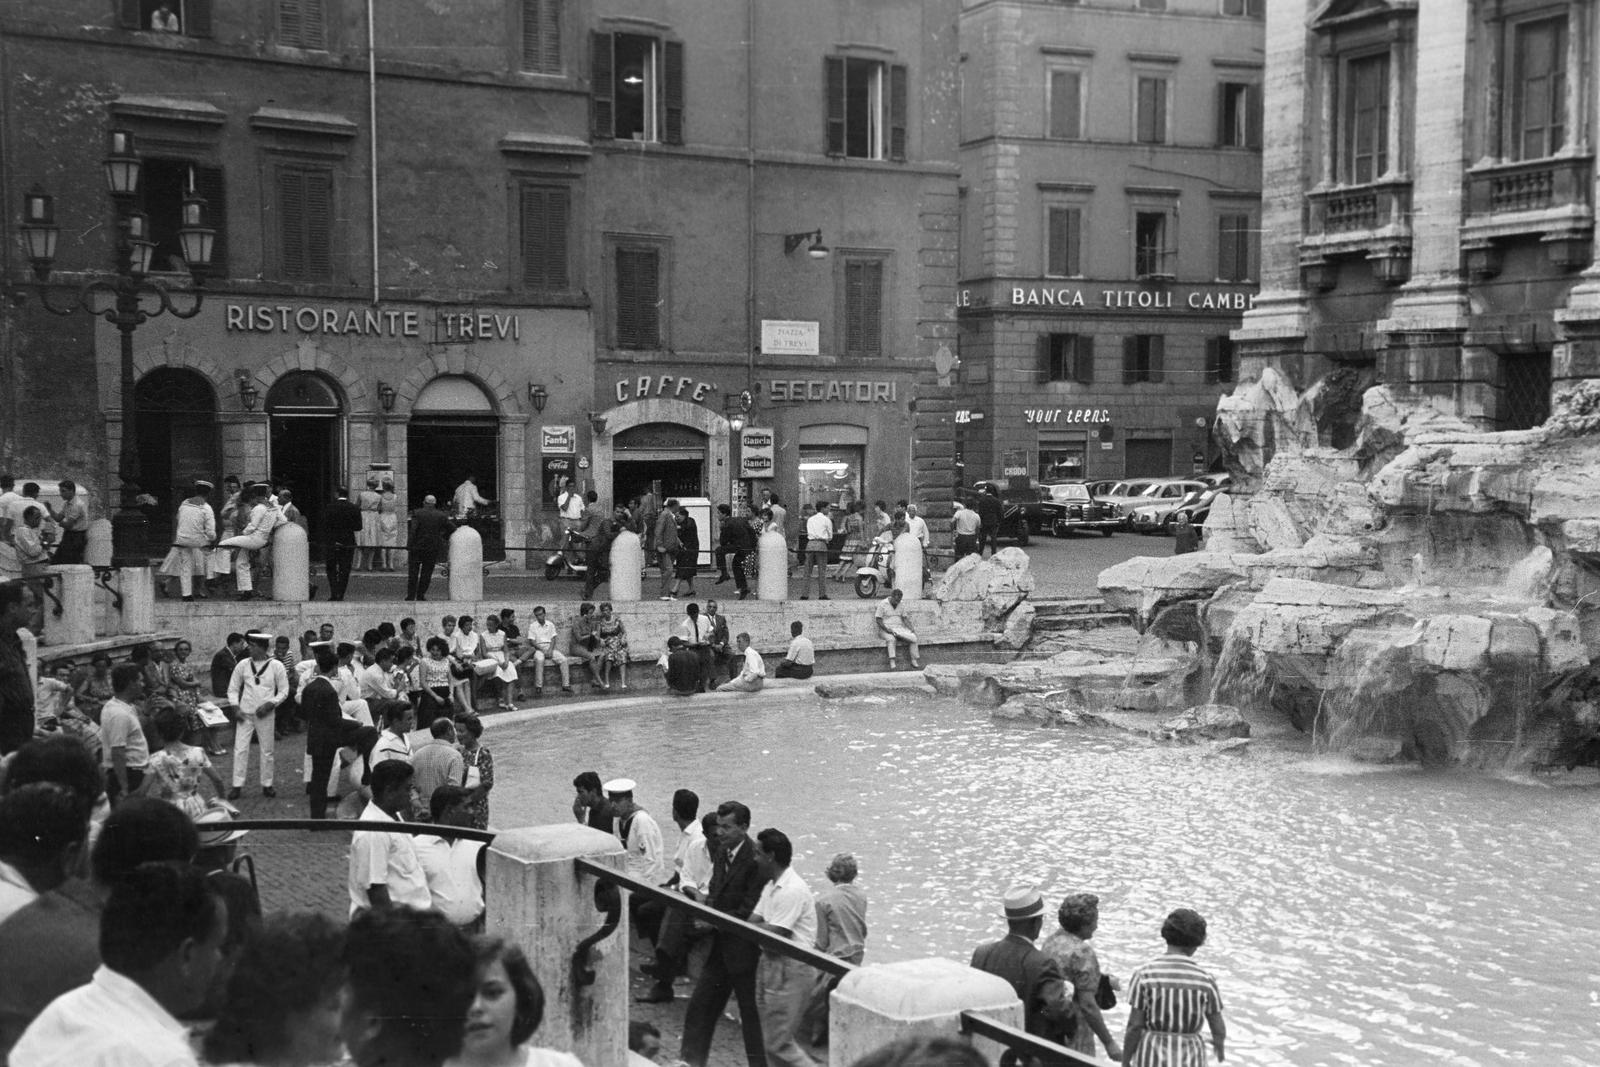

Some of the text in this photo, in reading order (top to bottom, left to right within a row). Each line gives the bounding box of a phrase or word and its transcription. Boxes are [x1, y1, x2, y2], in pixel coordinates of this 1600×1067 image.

[1012, 287, 1085, 306] BANCA
[1102, 290, 1172, 308] TITOLI
[226, 304, 521, 340] RISTORANTE TREVI
[770, 379, 897, 403] SEGATORI
[545, 435, 568, 446] Fanta
[744, 436, 771, 446] Gancia
[744, 458, 771, 468] Gancia
